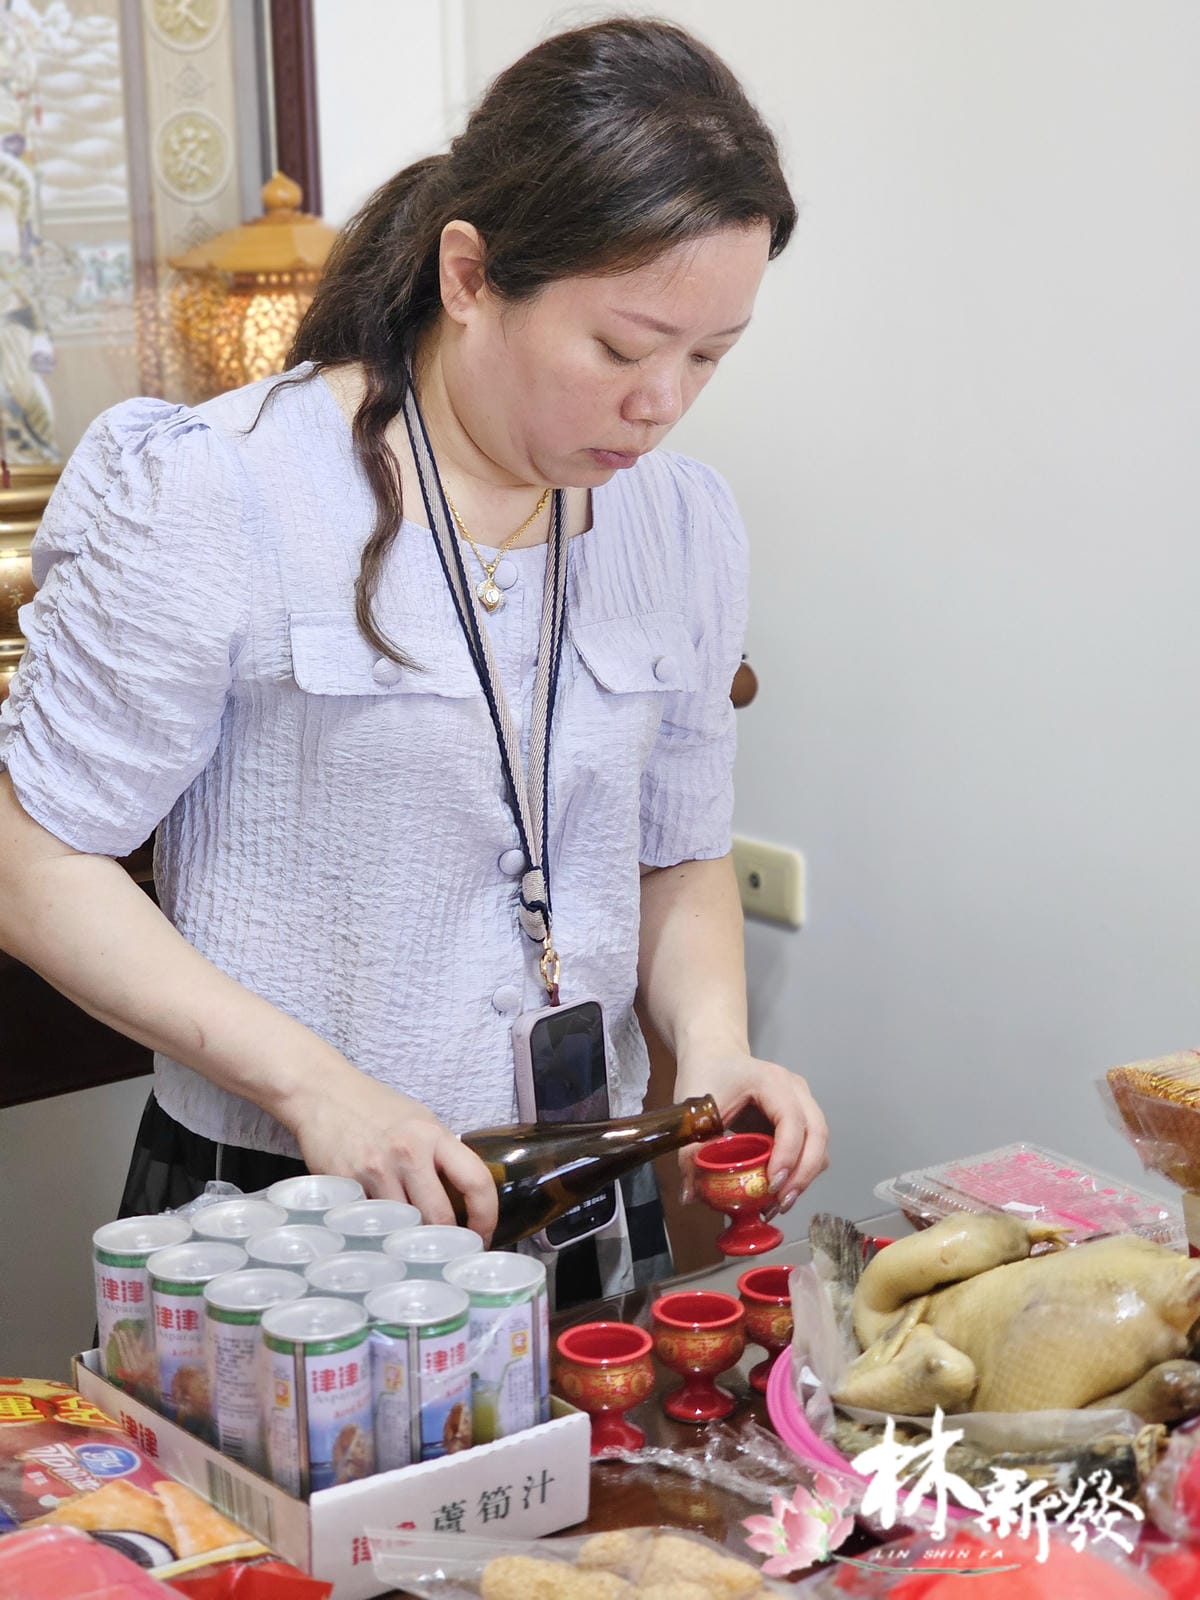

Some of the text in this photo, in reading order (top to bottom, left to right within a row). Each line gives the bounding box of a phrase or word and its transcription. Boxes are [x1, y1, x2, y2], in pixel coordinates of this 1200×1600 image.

[101, 1276, 144, 1303] 津津
[155, 1304, 199, 1331] 津津
[426, 1341, 465, 1375] 津津
[311, 1362, 359, 1394] 津津
[431, 1469, 556, 1534] 蘆筍汁
